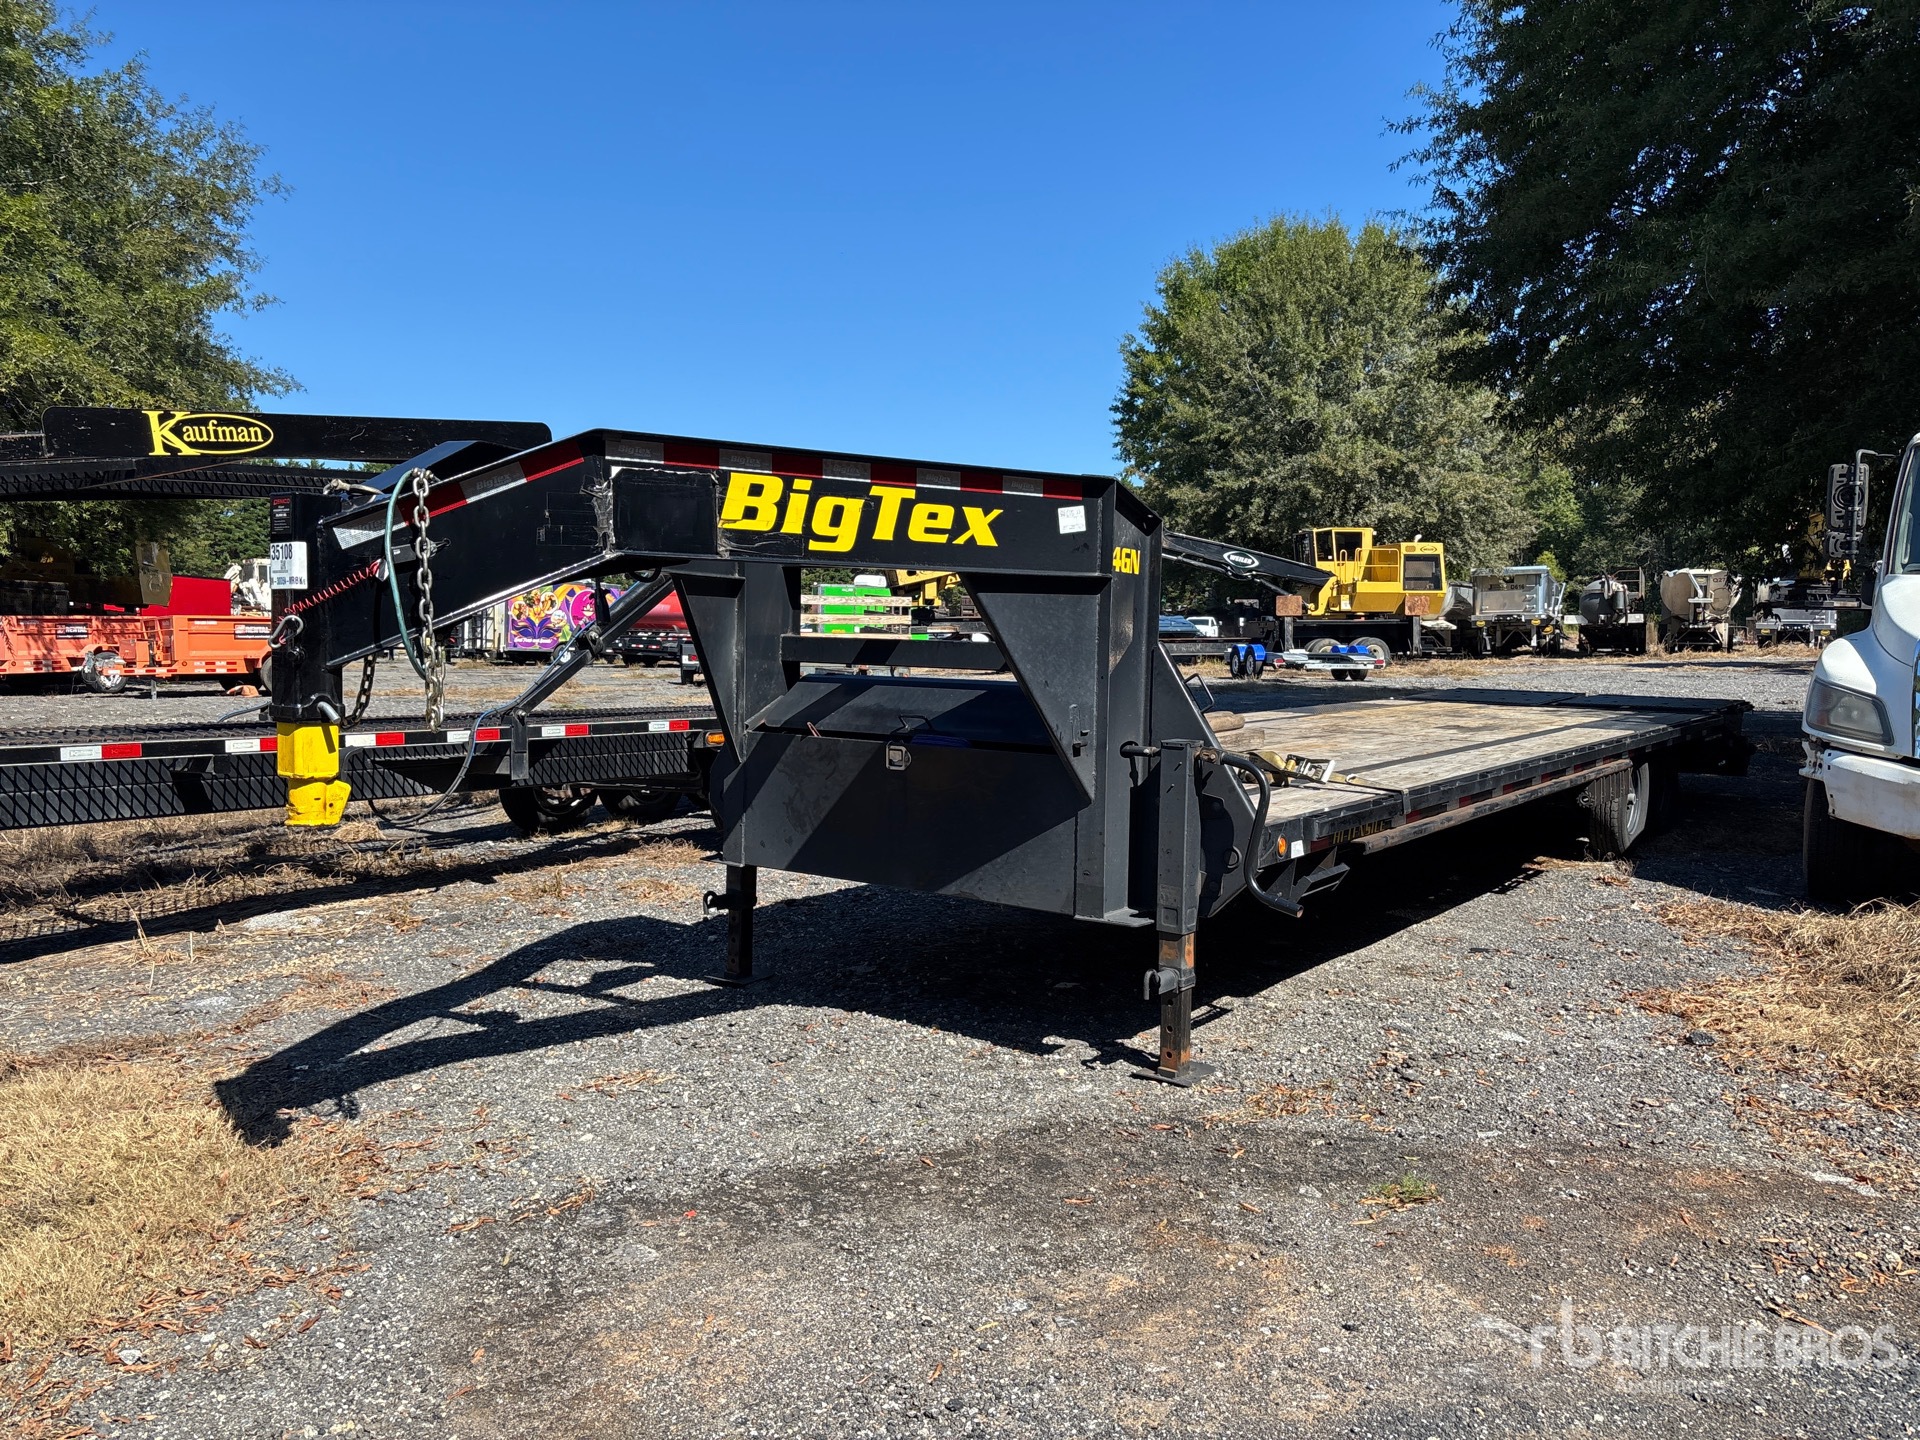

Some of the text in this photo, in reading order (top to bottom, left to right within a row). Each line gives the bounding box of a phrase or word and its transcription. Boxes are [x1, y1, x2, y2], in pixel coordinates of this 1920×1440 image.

[142, 410, 264, 456] Kaufman
[718, 472, 1003, 552] BigTex
[271, 544, 293, 560] 35108
[1230, 554, 1252, 564] WEILER
